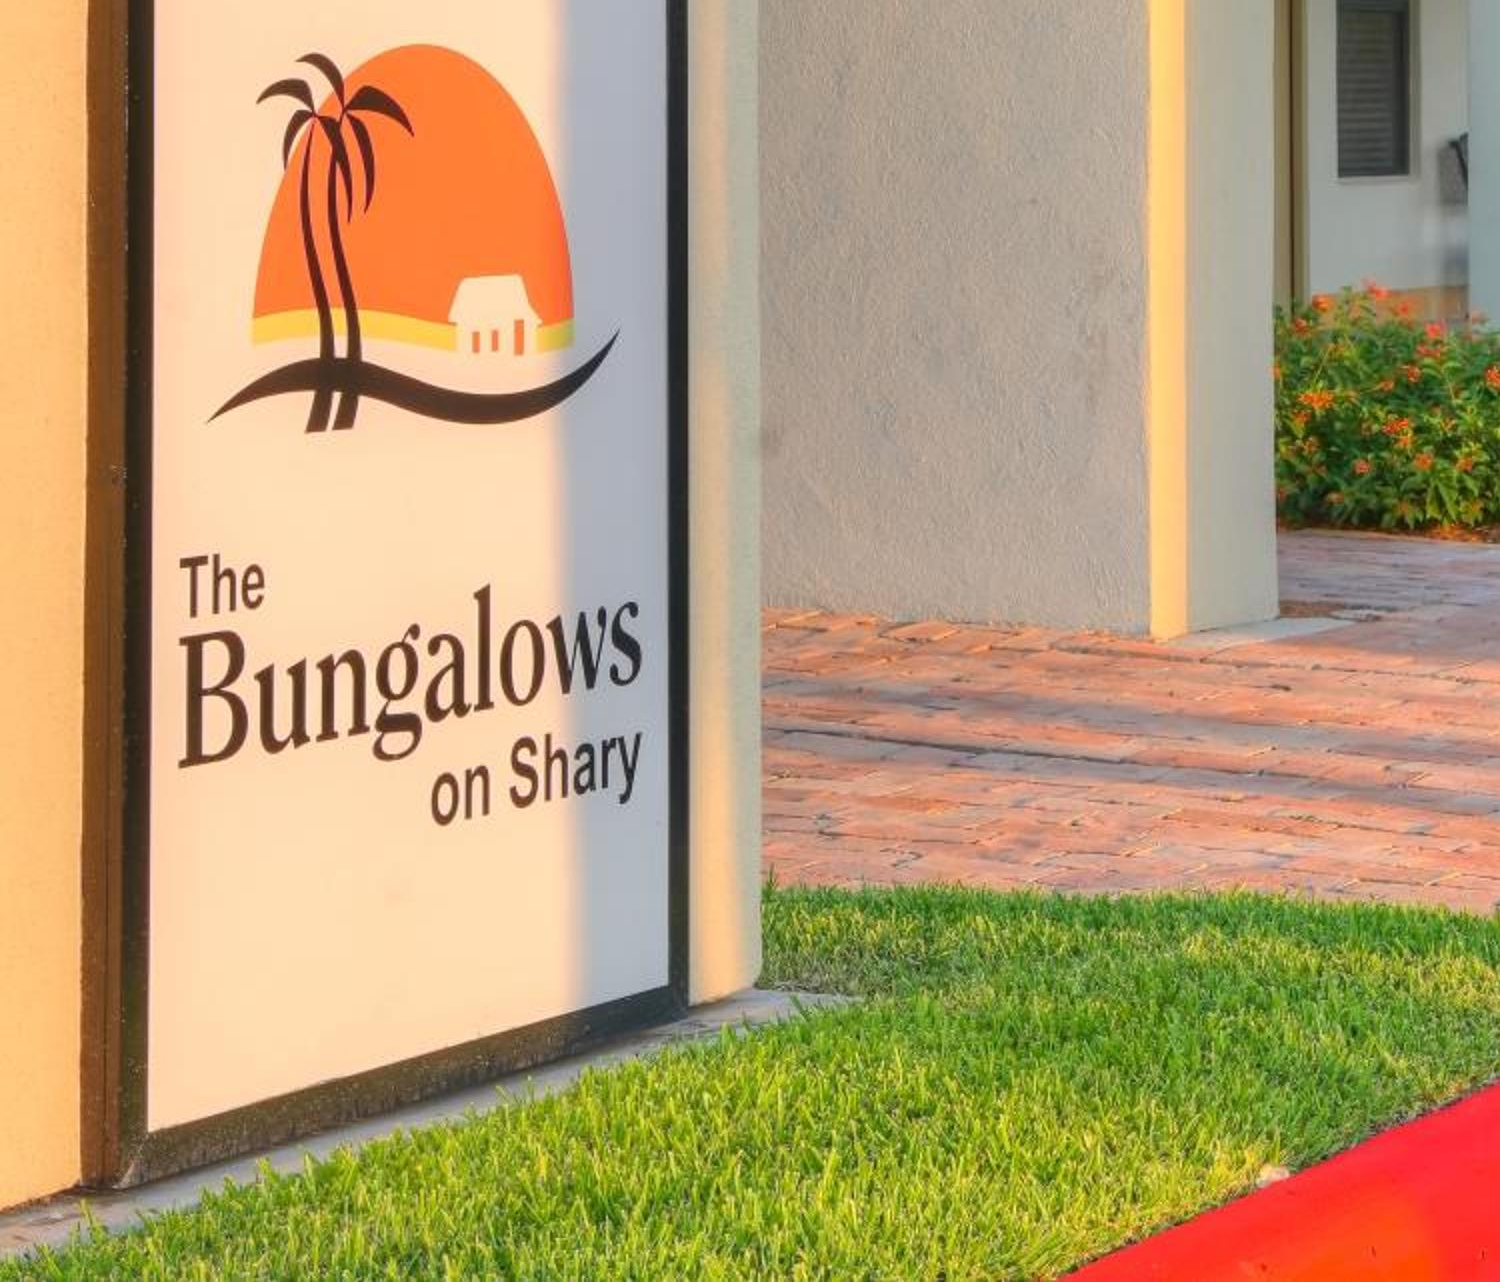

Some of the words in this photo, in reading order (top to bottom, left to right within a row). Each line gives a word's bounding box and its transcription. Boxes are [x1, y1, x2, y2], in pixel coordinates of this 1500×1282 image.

[179, 553, 265, 619] The
[178, 583, 643, 769] Bungalows
[431, 764, 490, 826] on
[509, 731, 642, 808] Shary
